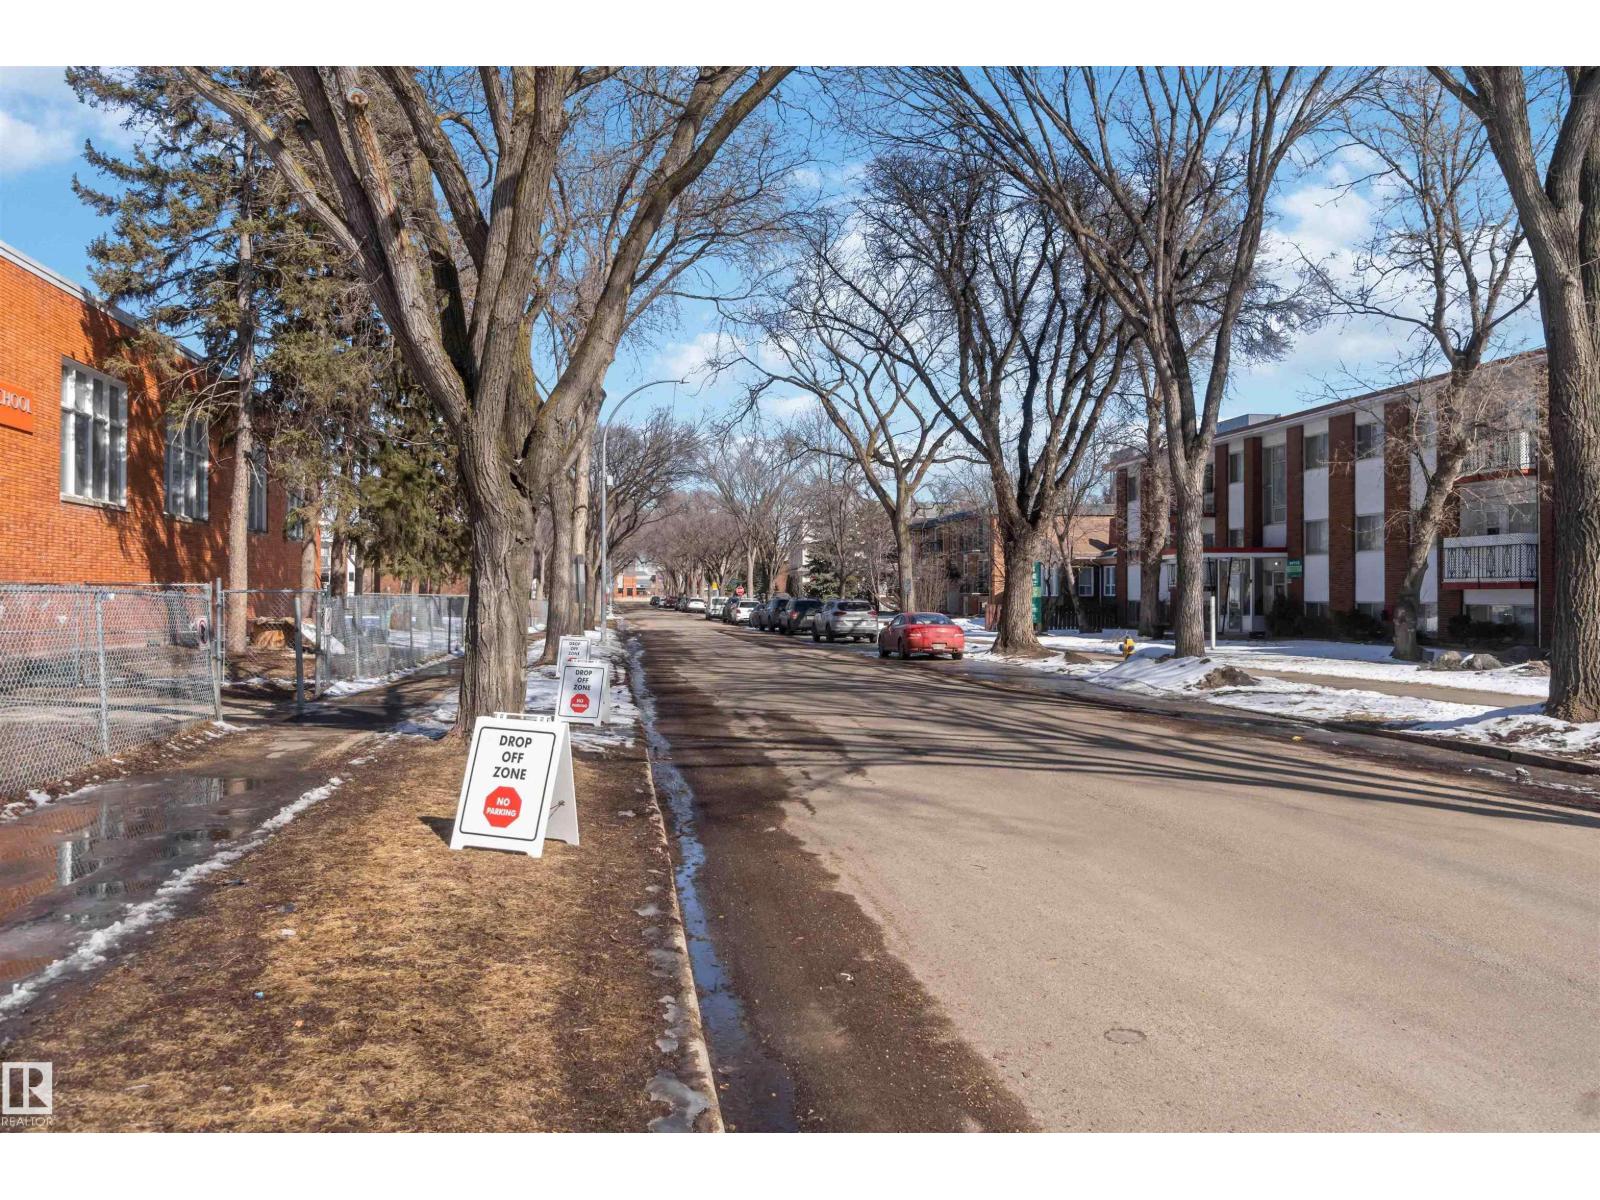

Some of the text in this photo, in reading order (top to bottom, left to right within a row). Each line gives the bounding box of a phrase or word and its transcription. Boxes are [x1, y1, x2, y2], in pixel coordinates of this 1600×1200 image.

[499, 735, 532, 748] DROP
[502, 751, 524, 763] OFF
[493, 766, 527, 780] ZONE
[496, 797, 510, 806] NO
[487, 807, 516, 816] PARKING
